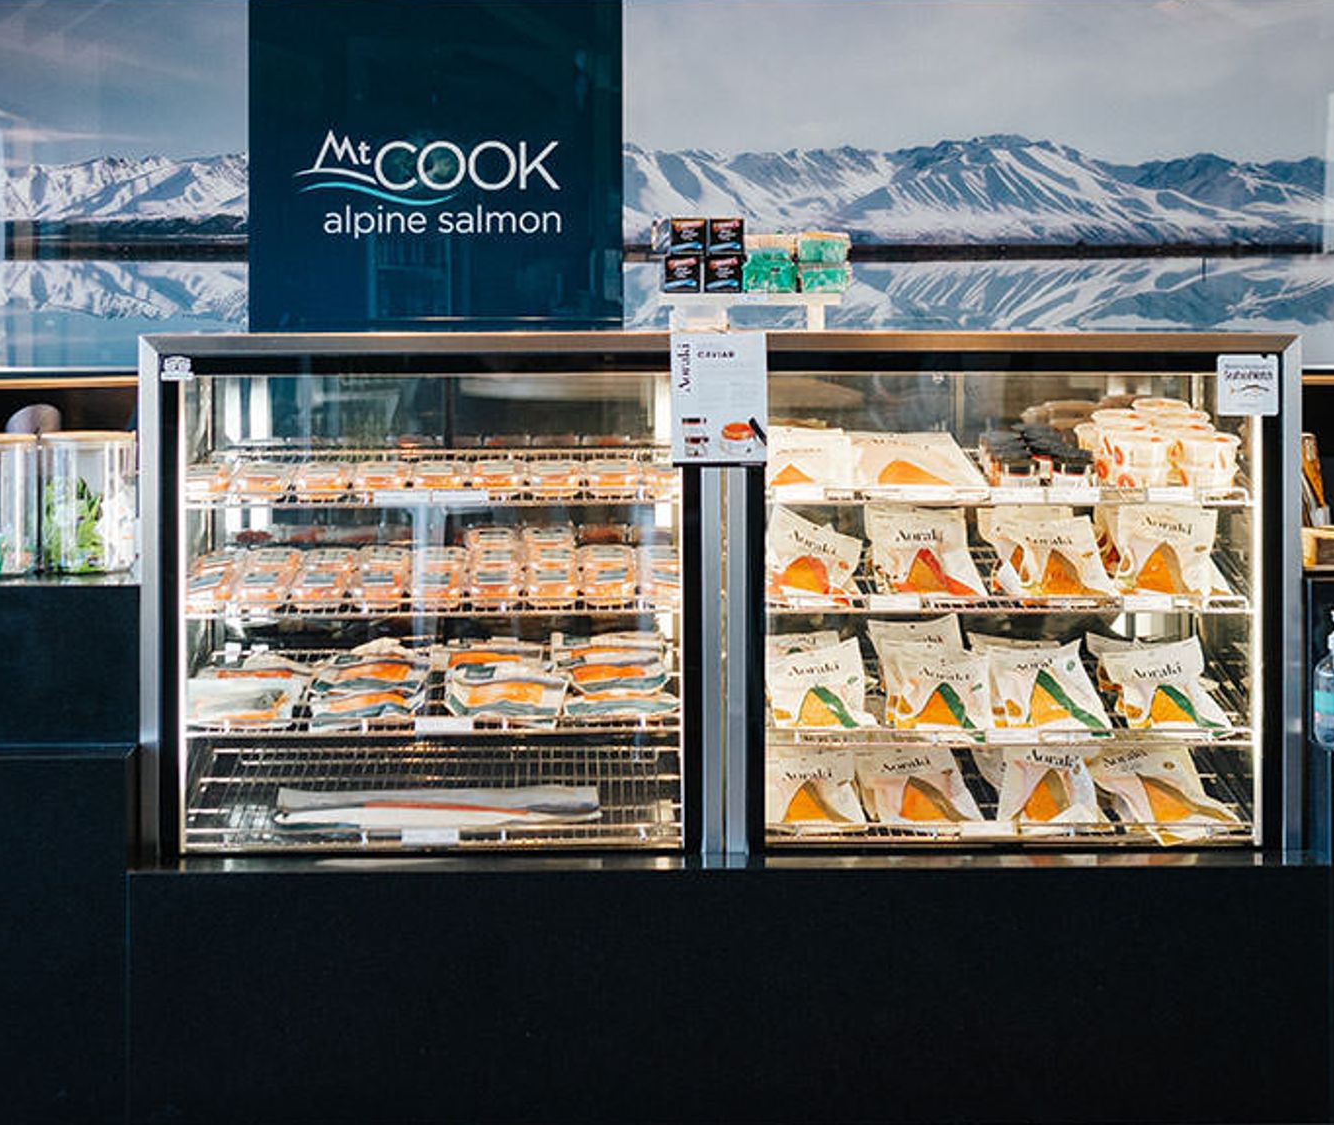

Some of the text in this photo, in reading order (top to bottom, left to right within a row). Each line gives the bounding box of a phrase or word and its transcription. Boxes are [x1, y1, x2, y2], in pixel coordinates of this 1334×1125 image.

[314, 130, 561, 192] Mt COOK
[323, 205, 562, 239] alpine salmon
